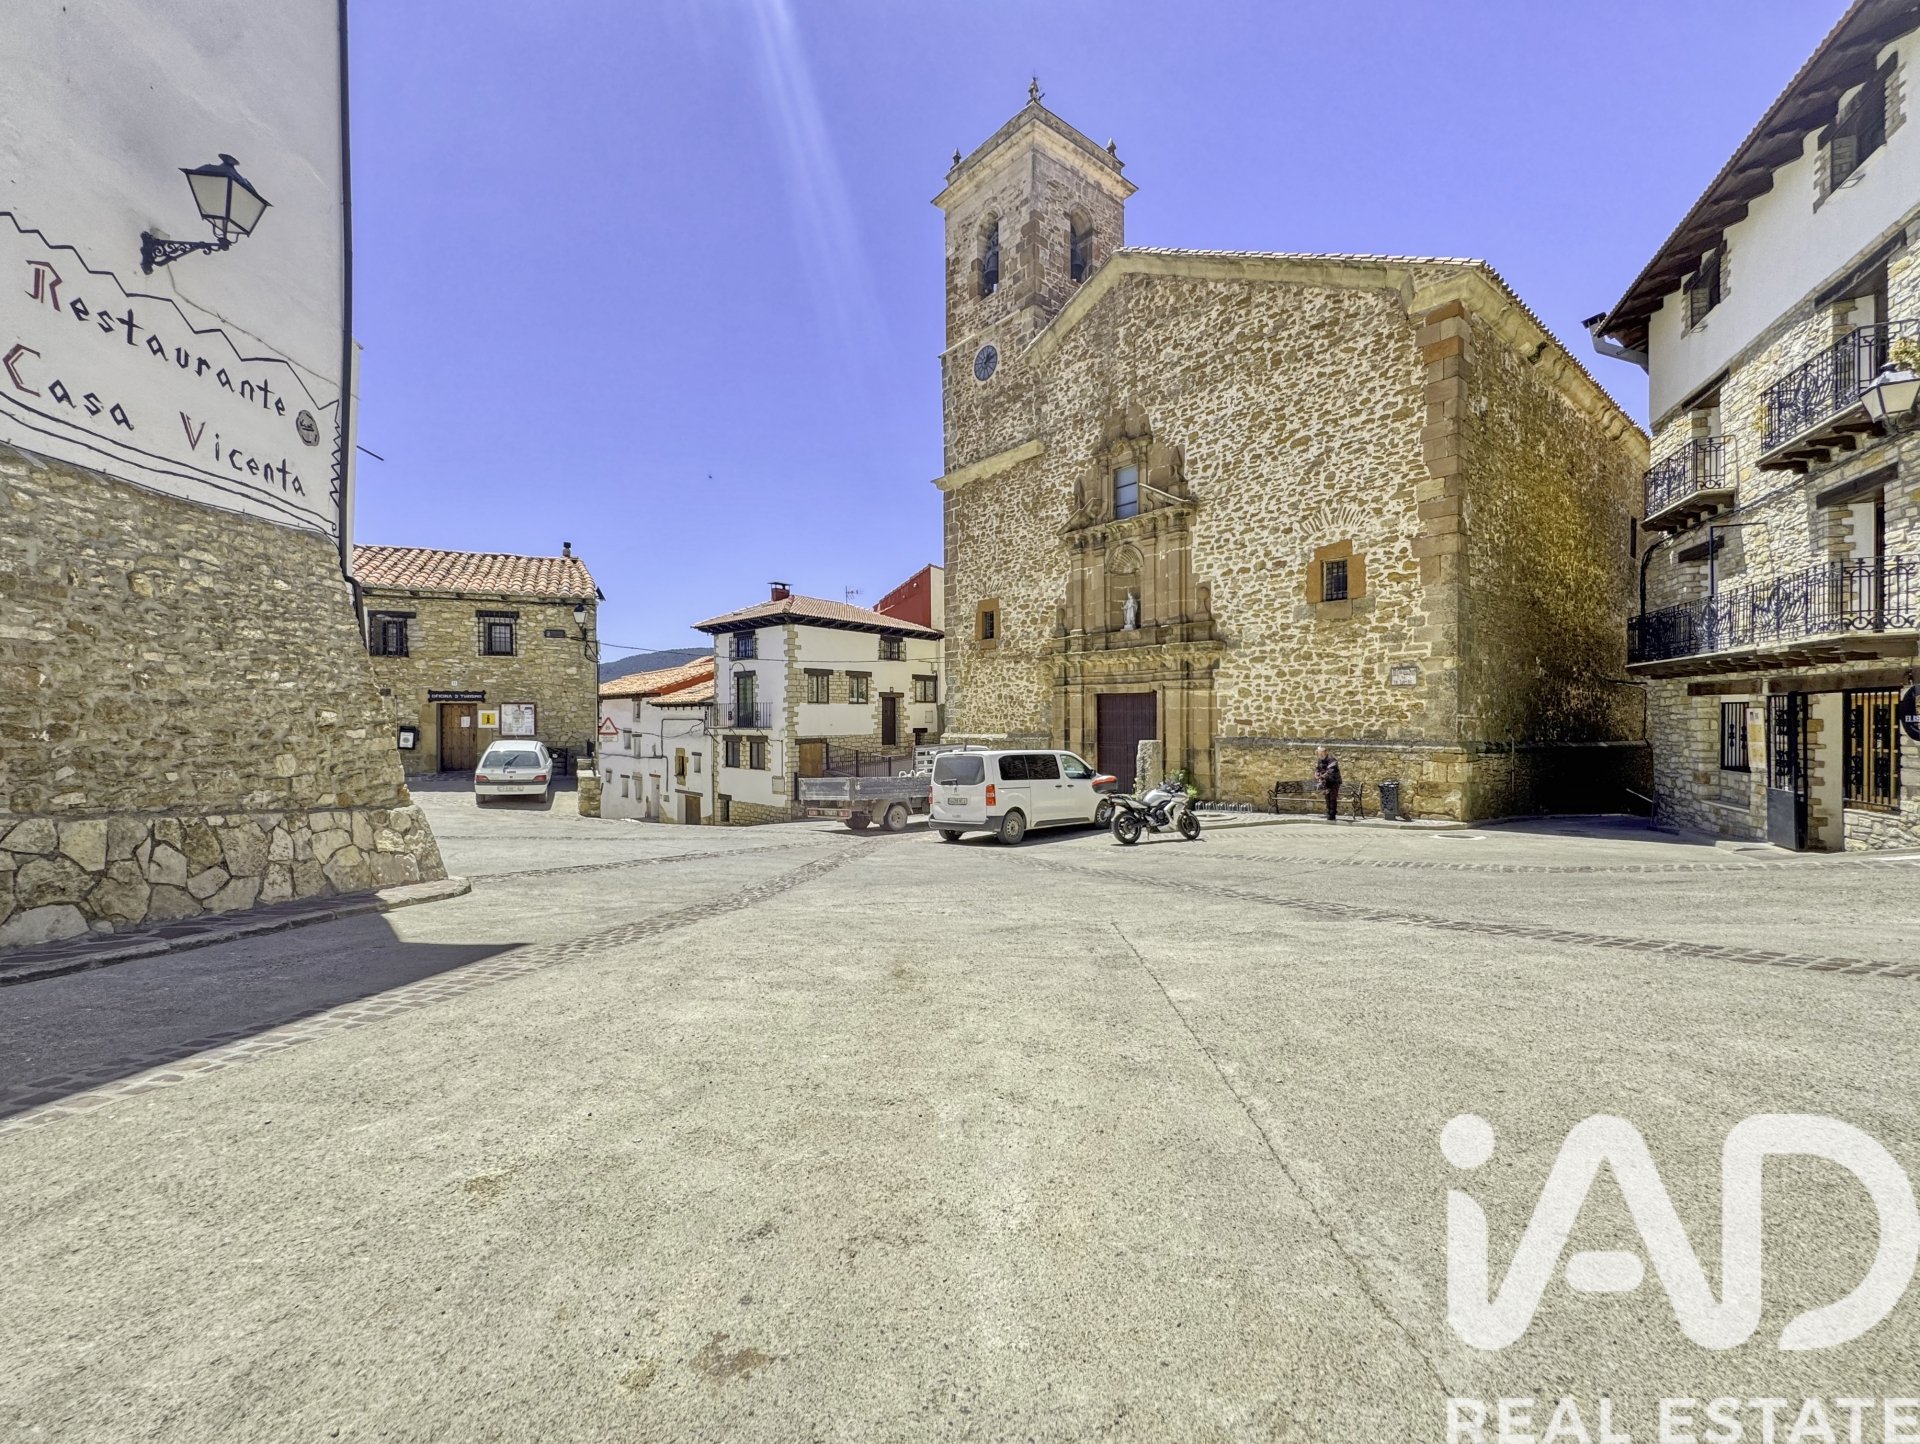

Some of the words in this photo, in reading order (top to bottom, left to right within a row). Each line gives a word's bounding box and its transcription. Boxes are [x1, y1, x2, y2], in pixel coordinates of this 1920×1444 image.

[25, 260, 286, 417] Restaurante
[2, 344, 134, 430] Casa
[179, 411, 306, 497] Vicenta
